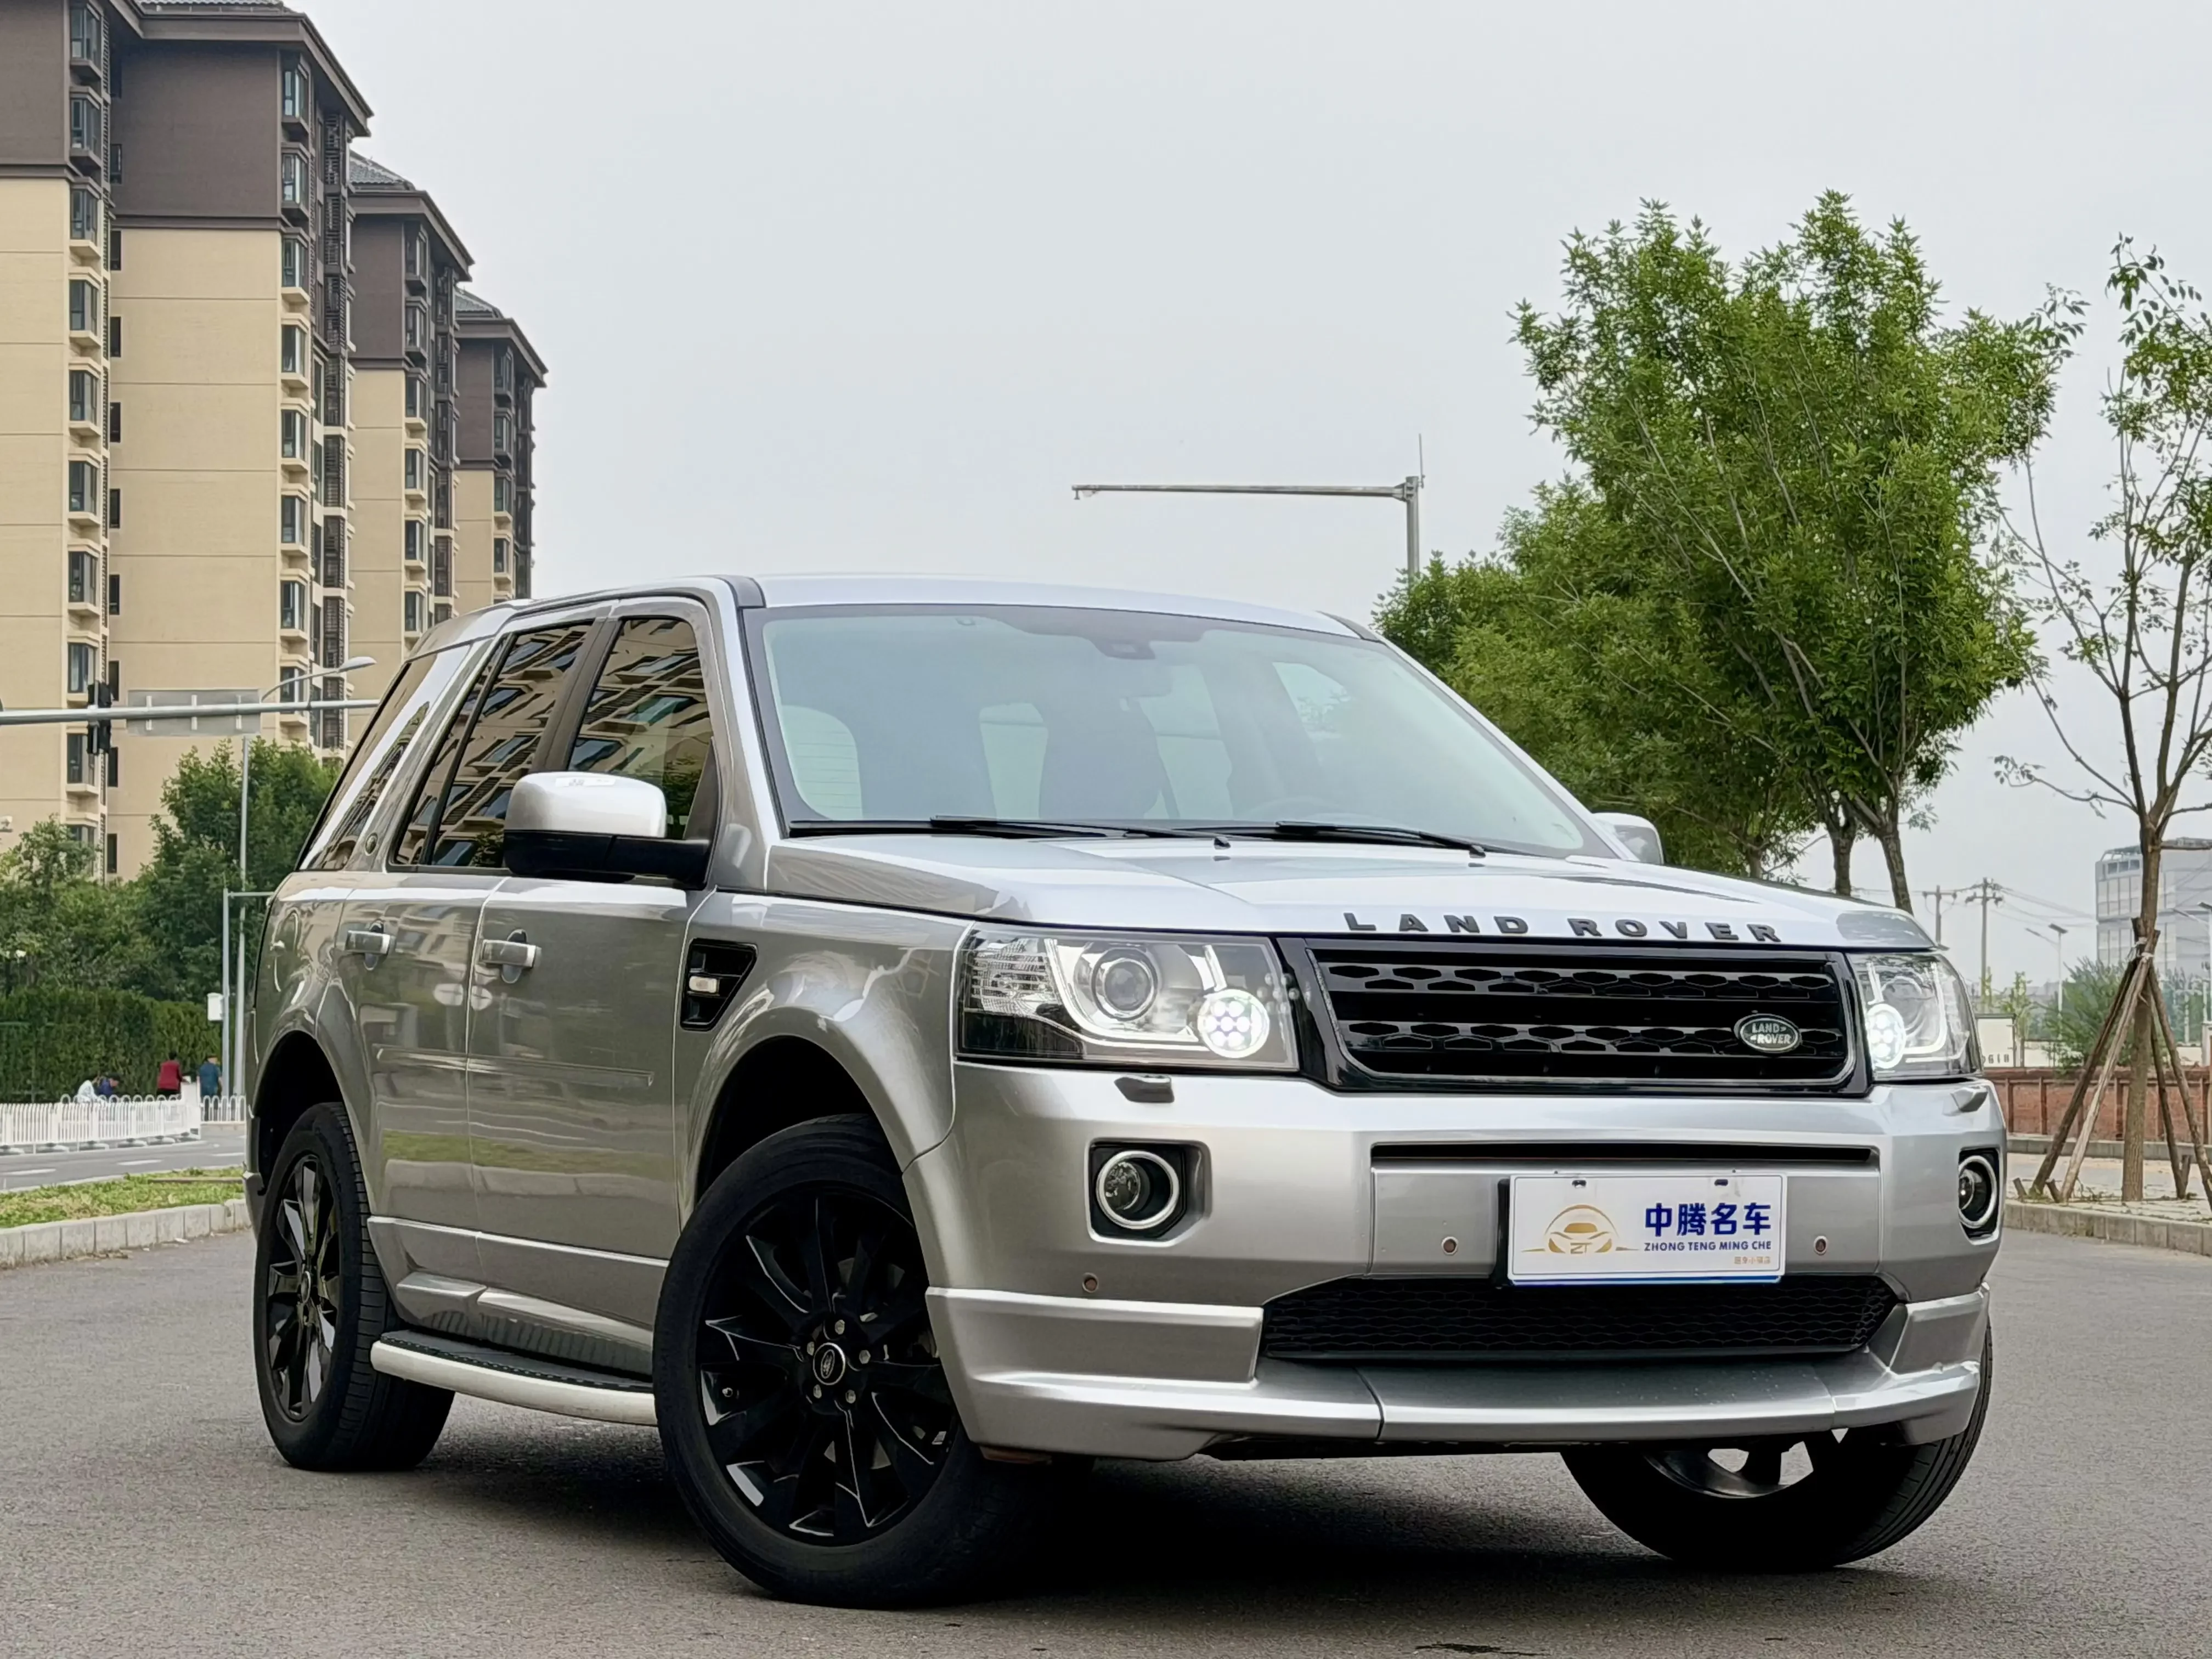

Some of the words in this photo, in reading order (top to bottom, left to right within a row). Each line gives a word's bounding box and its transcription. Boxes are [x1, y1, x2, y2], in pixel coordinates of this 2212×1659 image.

[1343, 912, 1530, 934] LAND
[1567, 918, 1782, 943] ROVER
[1752, 1023, 1780, 1034] LAND
[1757, 1034, 1791, 1044] ROVER
[1644, 1202, 1771, 1237] 中腾名车
[1644, 1242, 1685, 1252] ZHONG
[1688, 1242, 1717, 1251] TENG
[1719, 1240, 1749, 1251] MING
[1751, 1240, 1772, 1250] CHE
